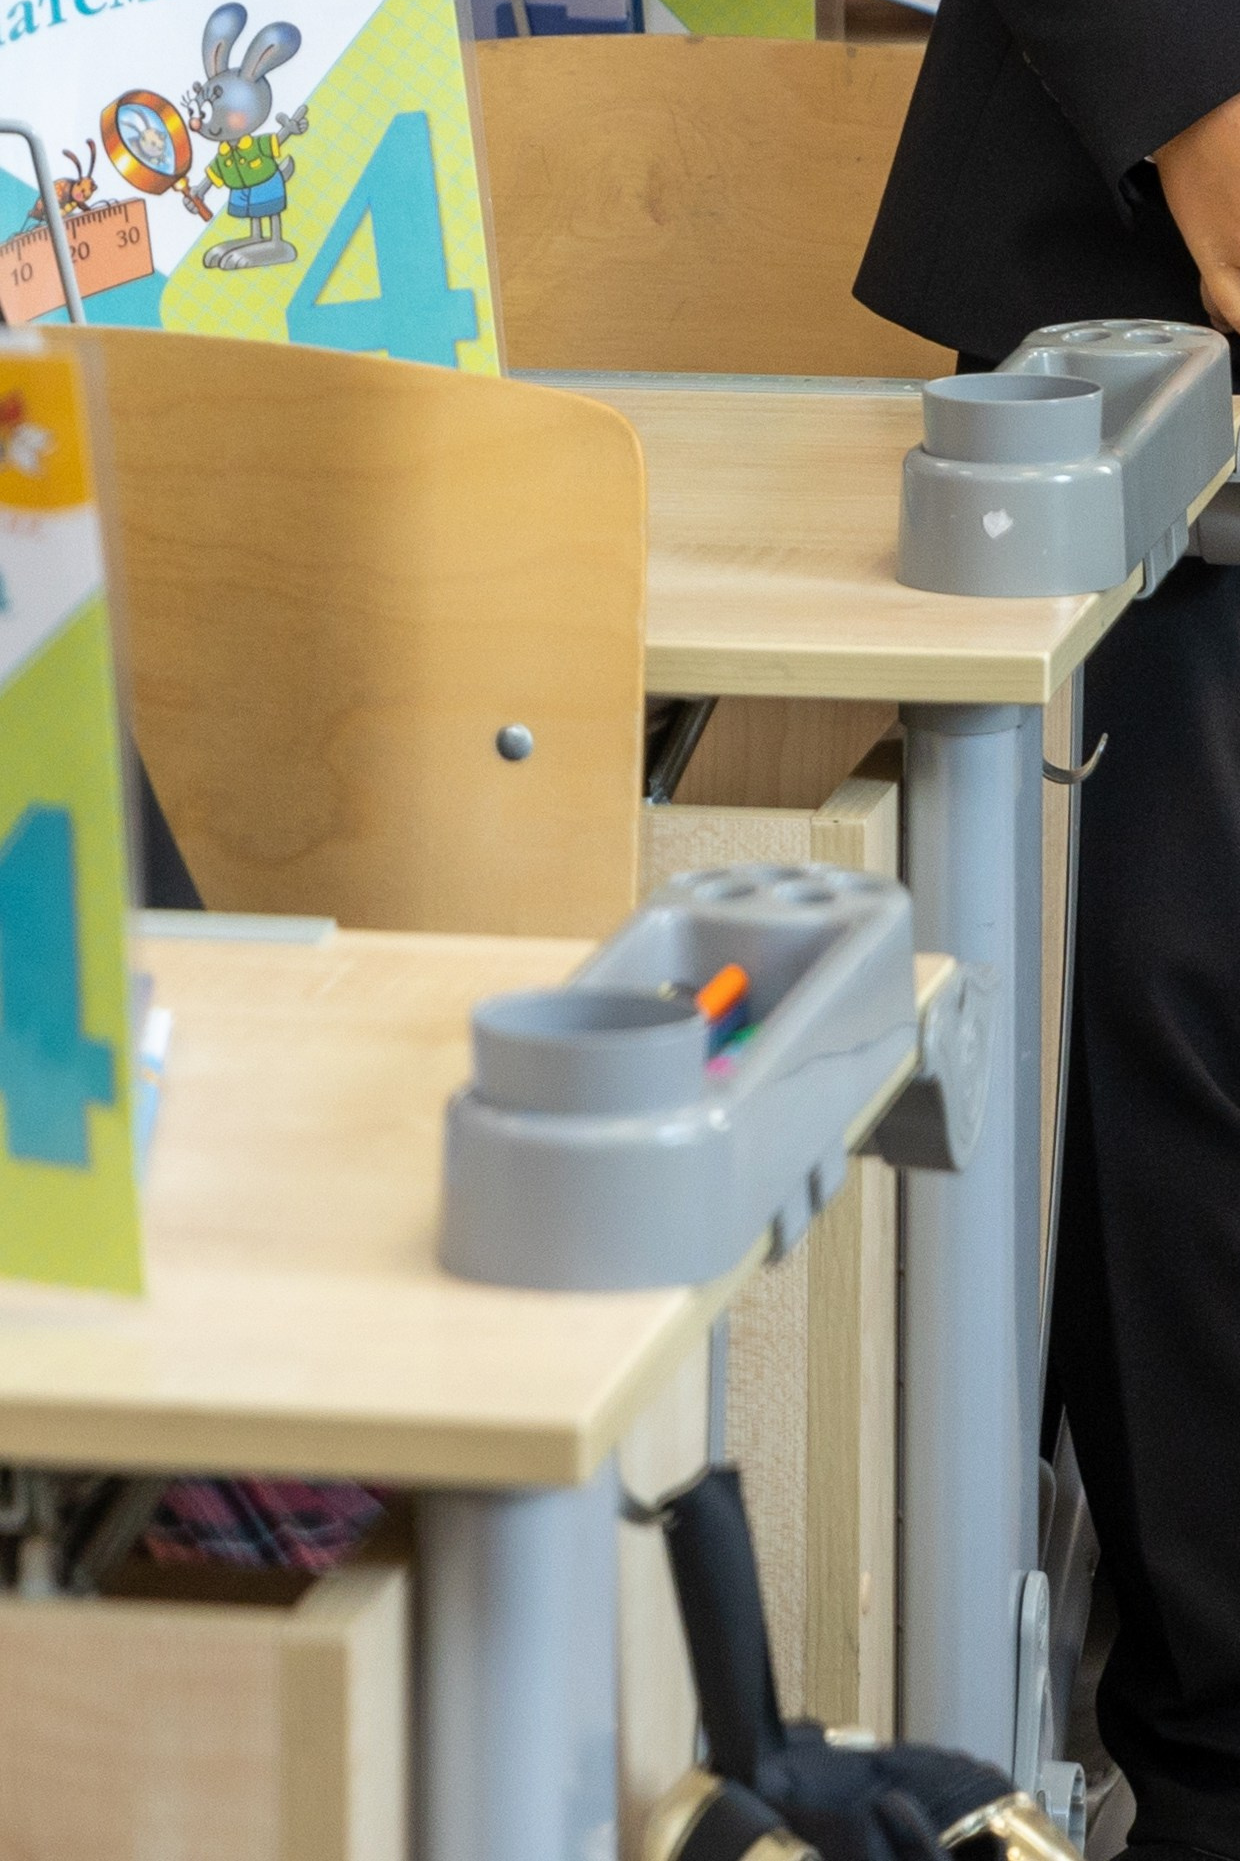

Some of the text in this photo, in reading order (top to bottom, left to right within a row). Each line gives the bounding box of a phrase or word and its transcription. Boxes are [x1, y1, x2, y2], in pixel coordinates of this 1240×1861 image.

[116, 226, 140, 248] 30
[285, 110, 479, 368] 4
[11, 262, 33, 286] 10
